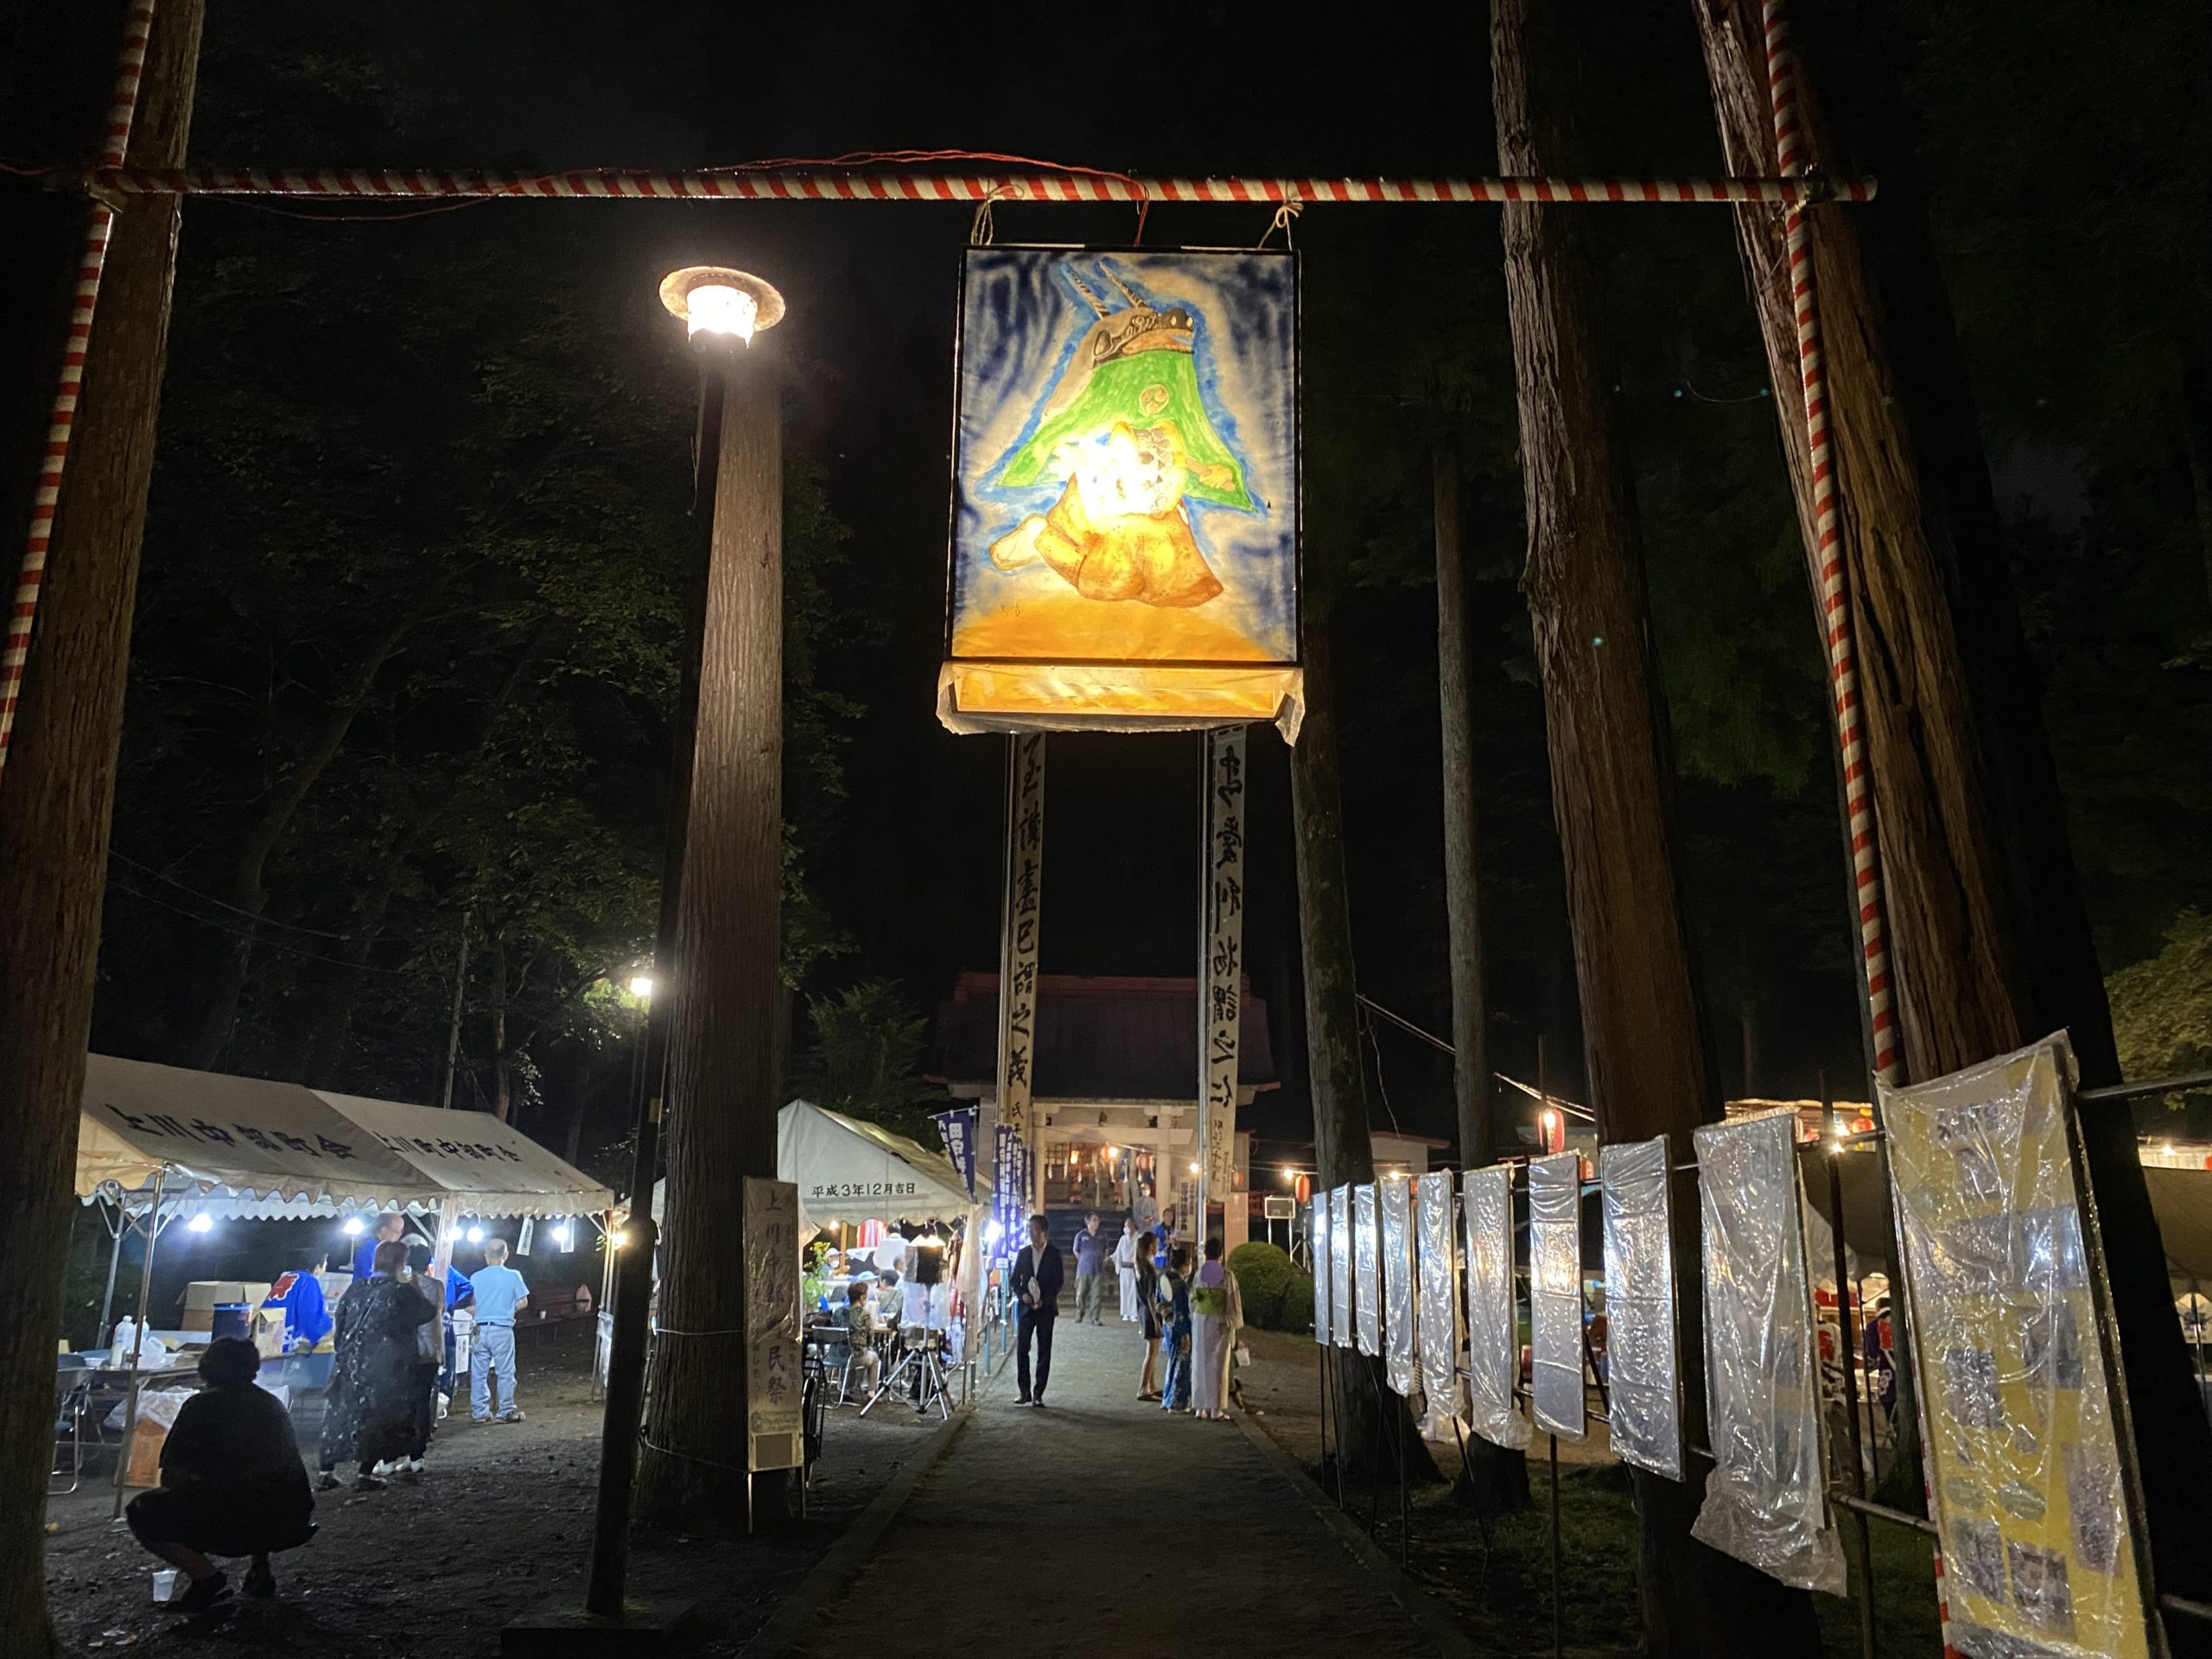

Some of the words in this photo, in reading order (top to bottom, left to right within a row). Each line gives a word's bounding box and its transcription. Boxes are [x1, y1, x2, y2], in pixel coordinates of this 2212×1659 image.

[811, 1182, 916, 1199] 平成3年12月吉日
